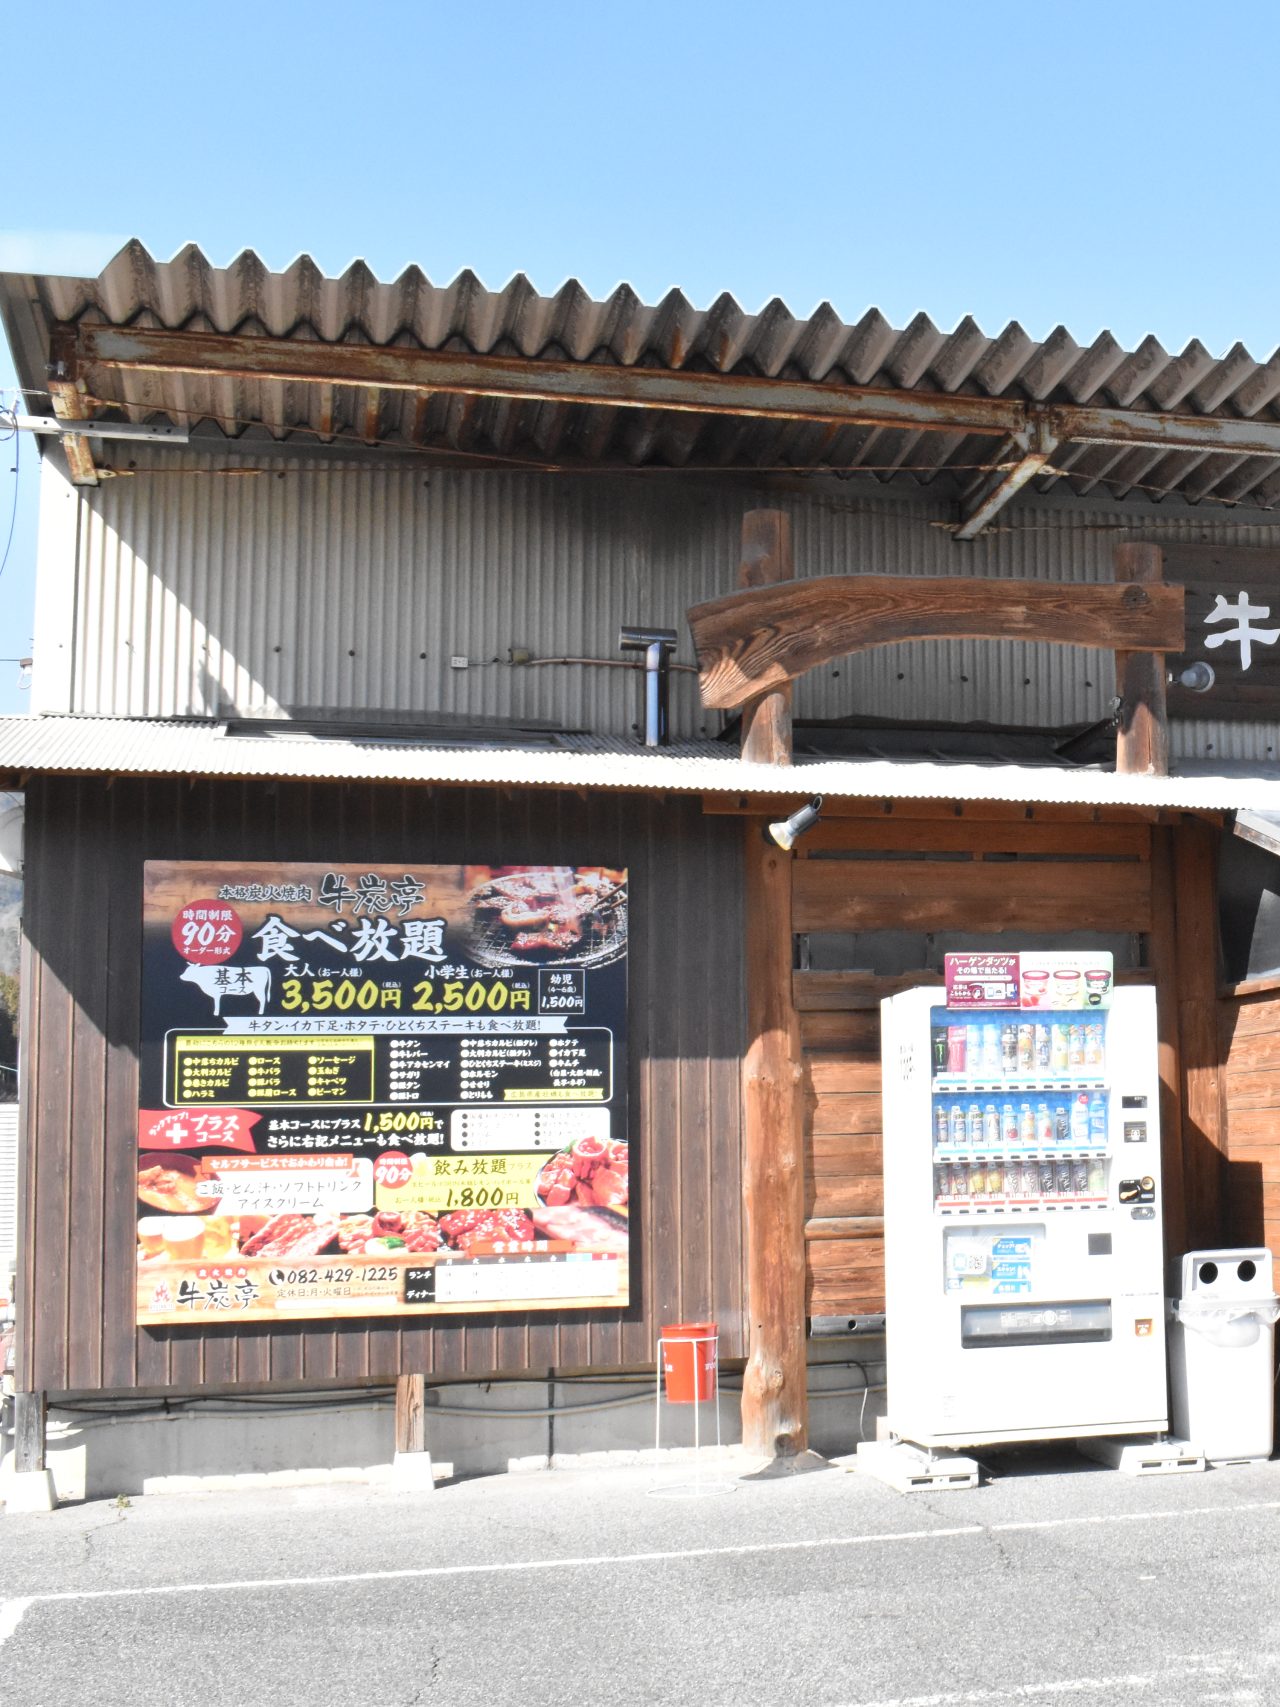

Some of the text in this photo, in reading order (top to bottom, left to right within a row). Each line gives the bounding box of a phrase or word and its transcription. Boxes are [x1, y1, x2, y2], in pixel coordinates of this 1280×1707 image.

[219, 873, 425, 916] 本格炭火焼肉 牛炭亭
[182, 909, 233, 921] 時間制限
[182, 921, 236, 946] 90分
[252, 916, 448, 962] 食べ放題
[183, 947, 231, 955] オーダー形式
[950, 957, 1016, 967] ハーゲンダッツが
[214, 967, 253, 986] 基本
[550, 974, 573, 985] 幼児
[220, 986, 247, 994] コース
[281, 979, 402, 1013] 3,500円
[412, 980, 531, 1014] 2,500円
[541, 996, 583, 1009] 1,500円
[256, 1057, 281, 1065] ロース
[317, 1056, 356, 1064] ソーセージ
[558, 1059, 580, 1067] キムチ
[317, 1077, 347, 1086] キャベツ
[191, 1090, 215, 1098] ハラミ
[190, 1115, 240, 1130] プラス
[196, 1131, 235, 1143] コース
[267, 1132, 444, 1149] さらに右記メニューも食べ放題!
[434, 1158, 507, 1176] 飲み放題
[376, 1166, 412, 1184] 90分
[238, 1197, 324, 1209] アイスクリーム
[445, 1187, 519, 1207] 1,800円
[287, 1267, 398, 1285] 082-429-1225
[409, 1270, 431, 1280] ランチ
[177, 1279, 259, 1310] 牛炭亭
